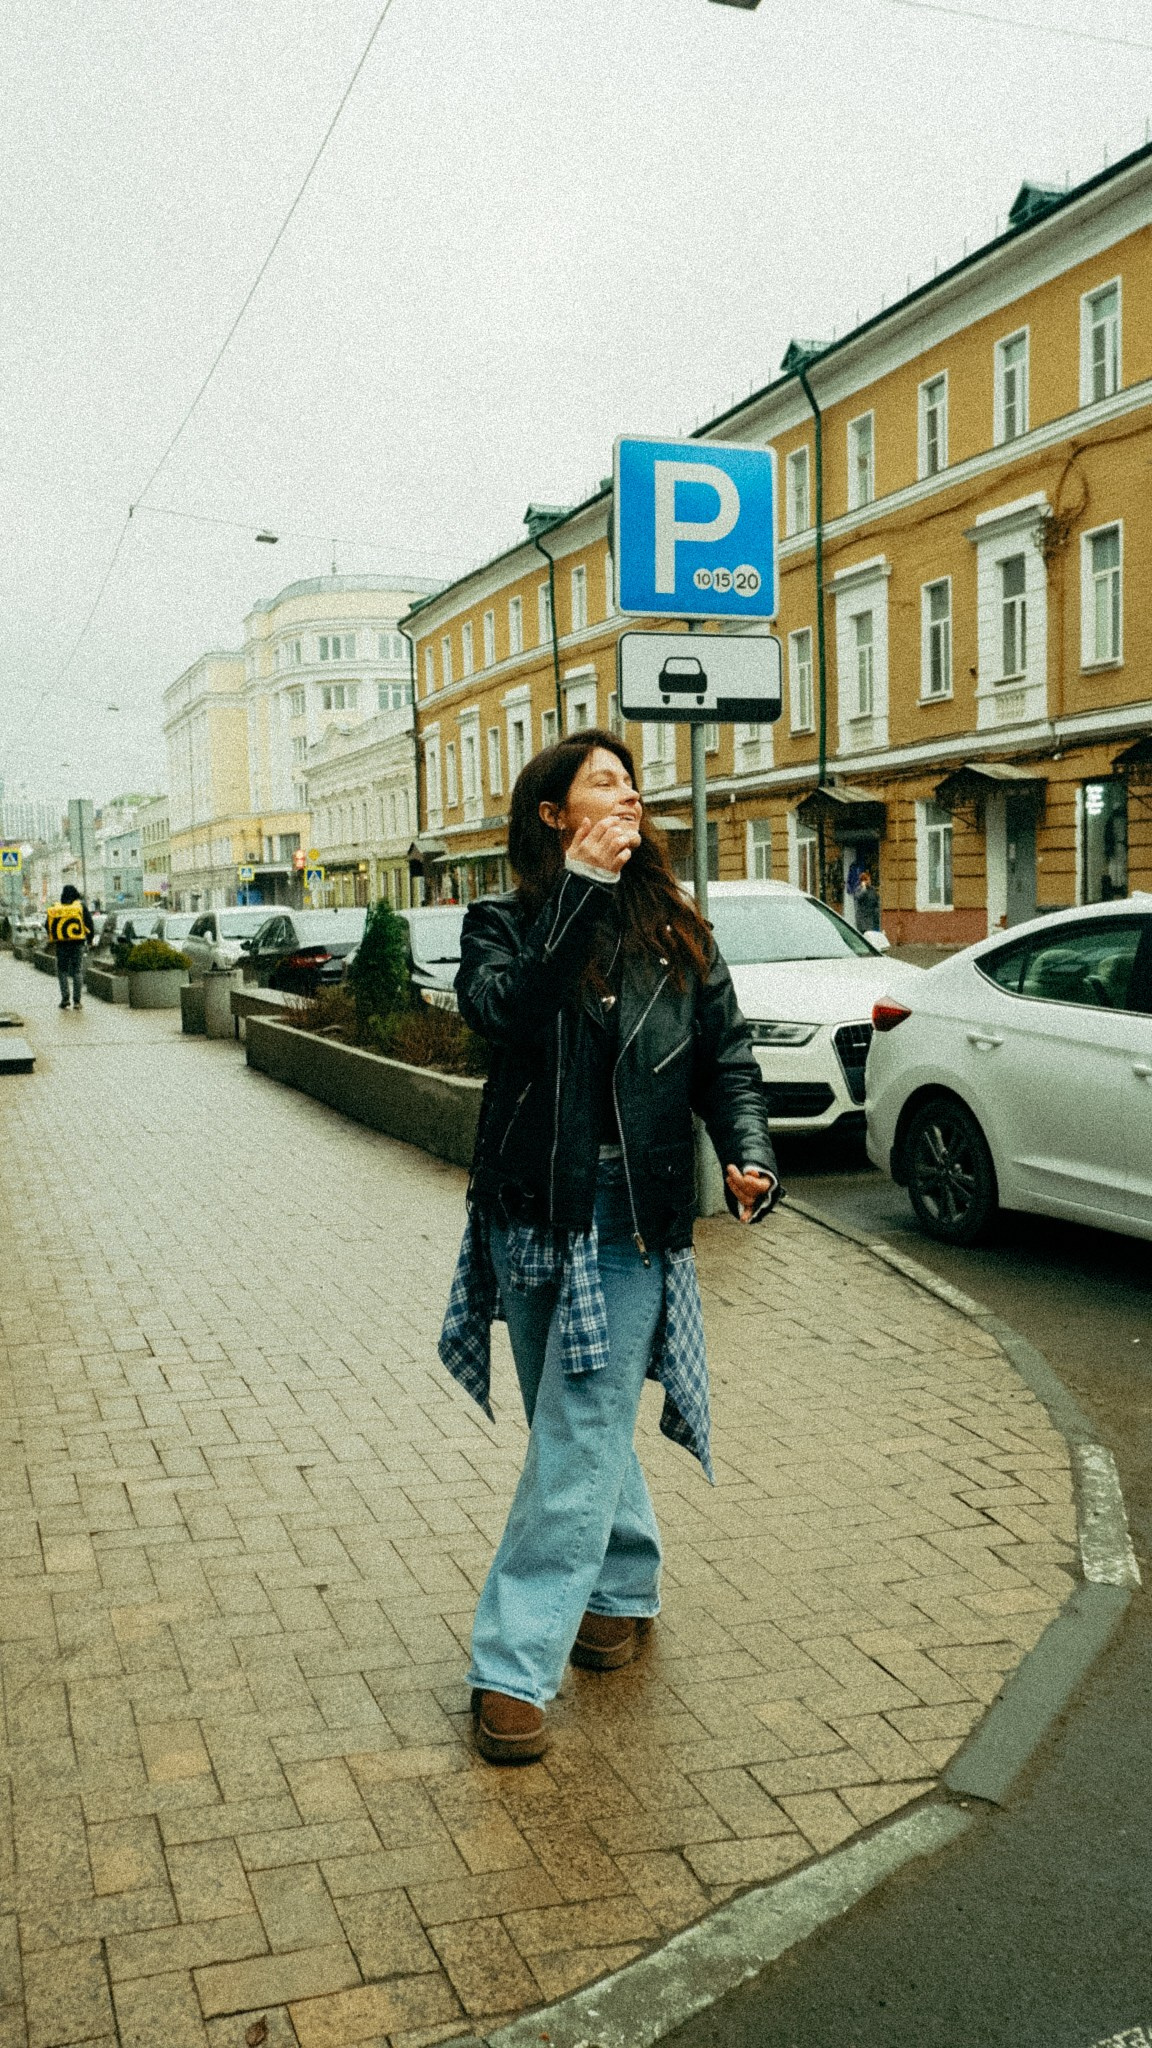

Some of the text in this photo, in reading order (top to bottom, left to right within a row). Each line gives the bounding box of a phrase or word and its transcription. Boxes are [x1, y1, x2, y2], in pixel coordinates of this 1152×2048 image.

[654, 460, 740, 594] P
[696, 573, 759, 590] 10 15 20
